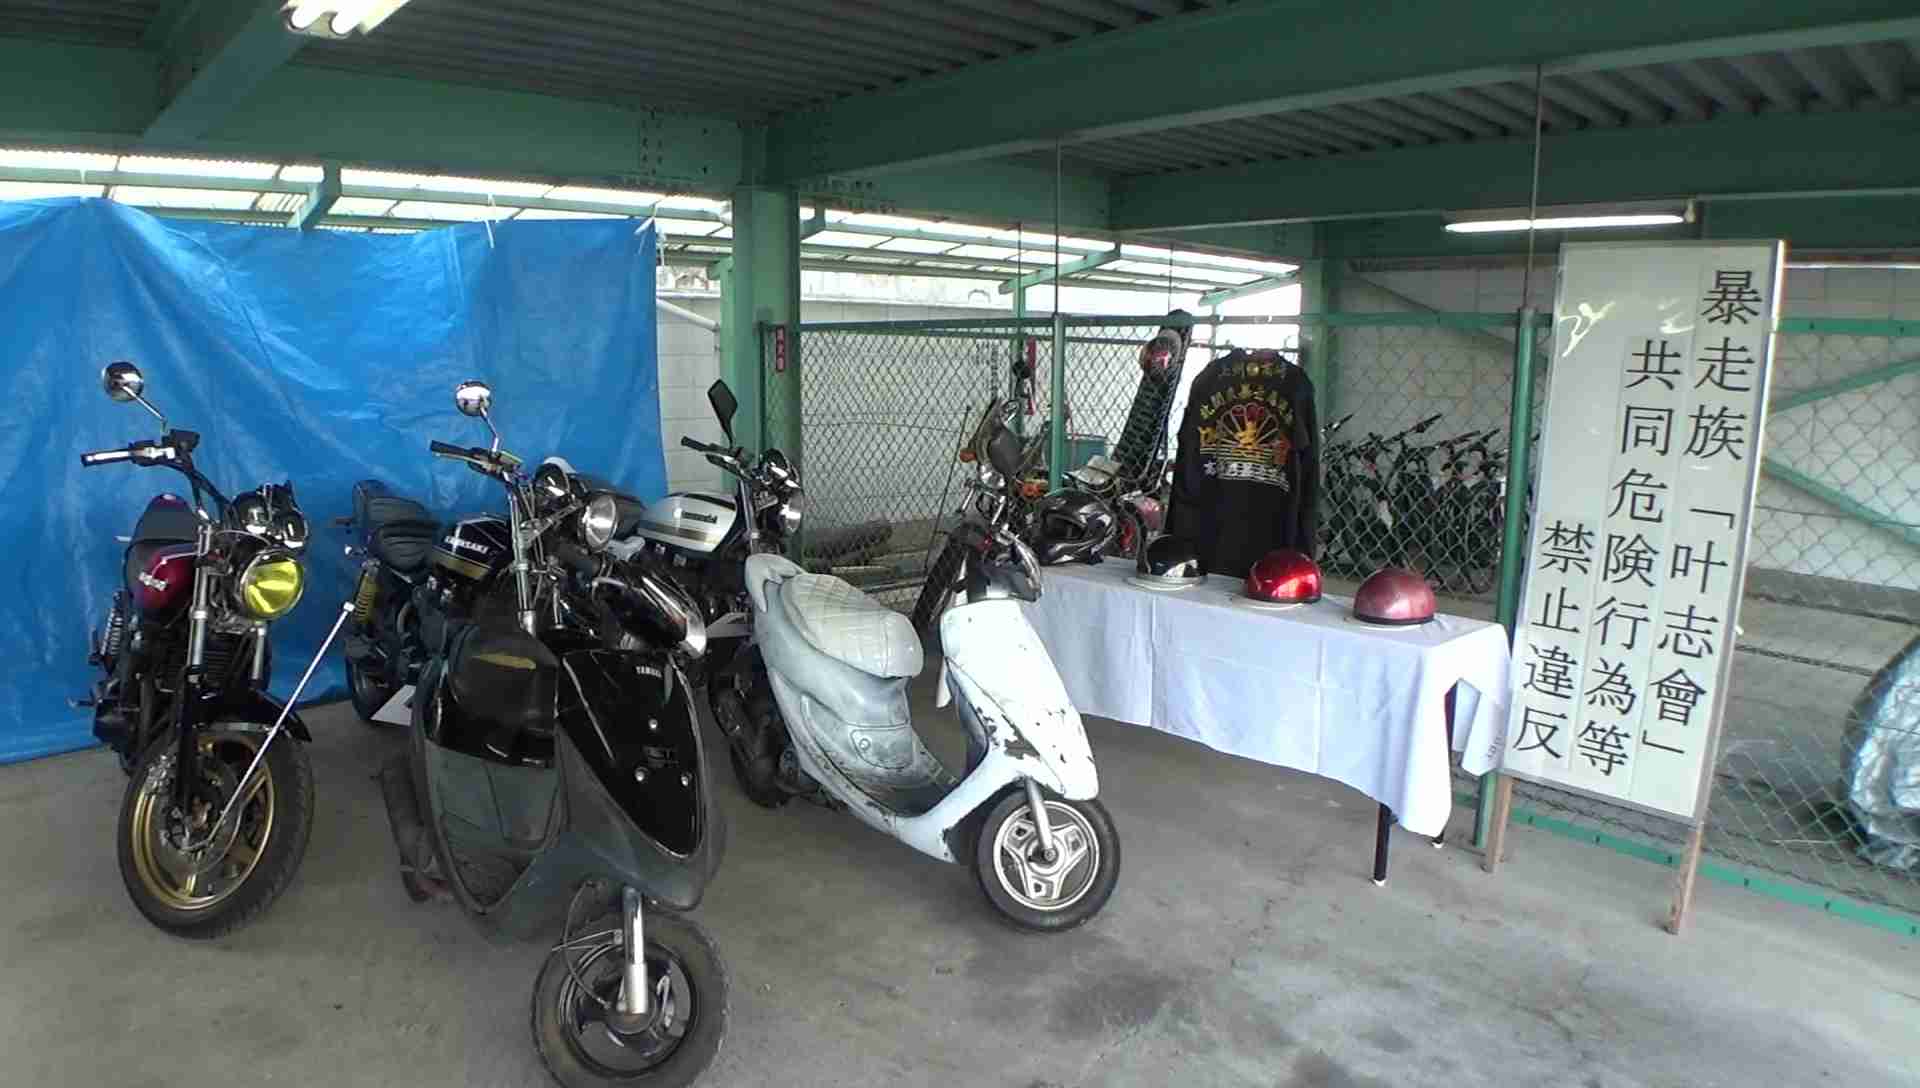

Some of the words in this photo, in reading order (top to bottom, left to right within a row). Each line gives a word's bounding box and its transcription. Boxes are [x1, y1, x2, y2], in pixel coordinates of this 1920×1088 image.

[1514, 521, 1596, 760] 禁止違反
[1577, 339, 1683, 776] 共同危険行為等
